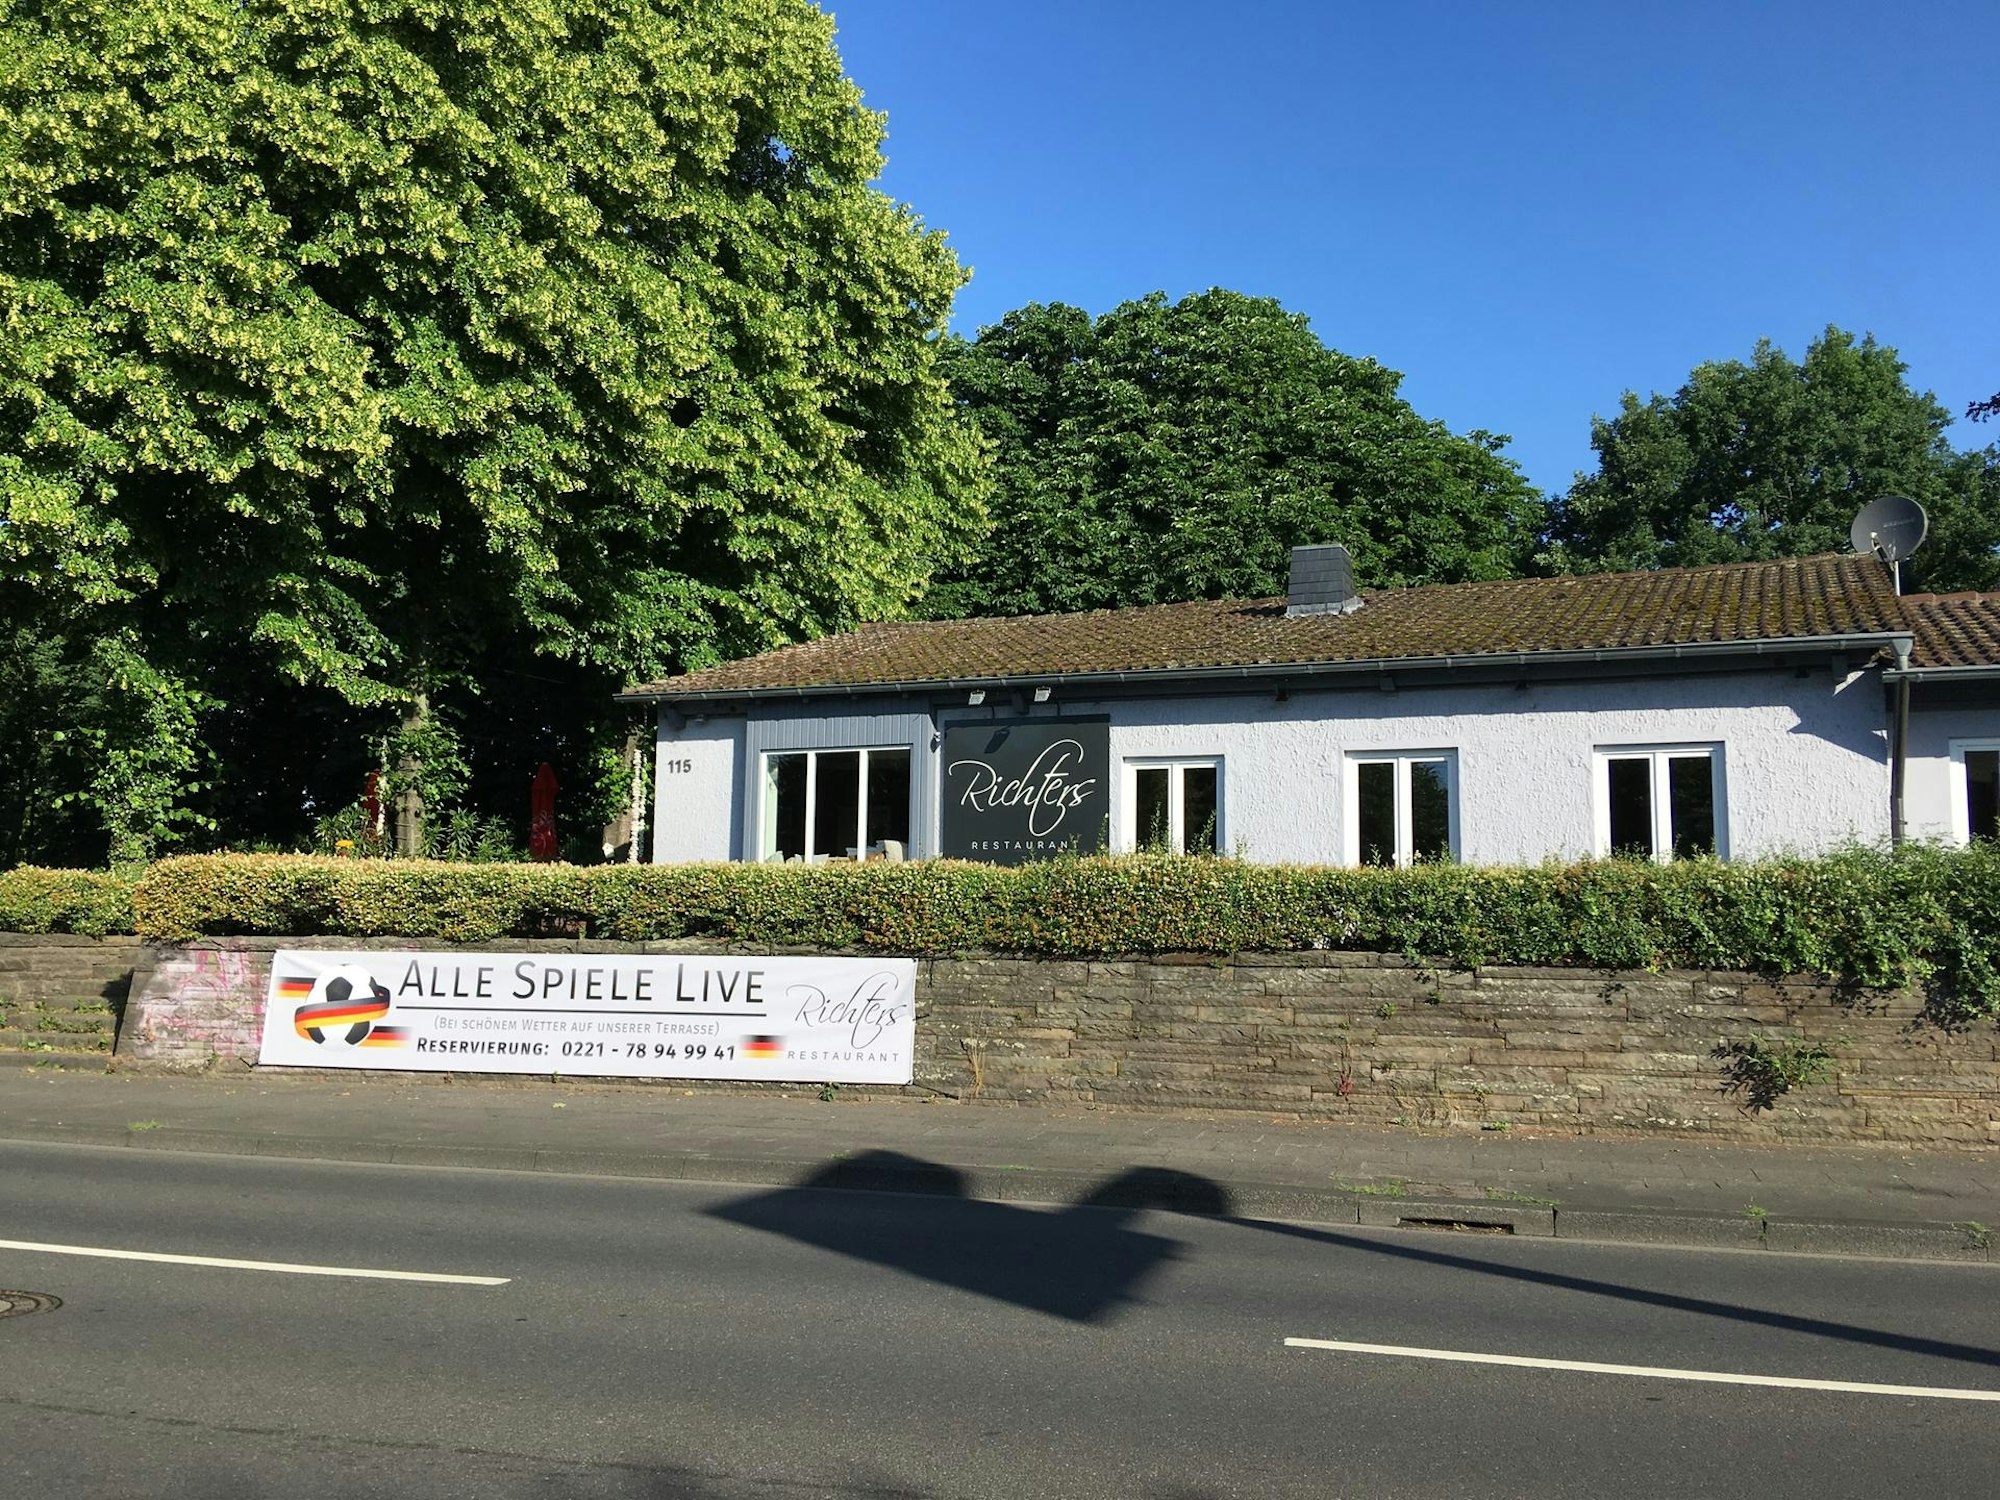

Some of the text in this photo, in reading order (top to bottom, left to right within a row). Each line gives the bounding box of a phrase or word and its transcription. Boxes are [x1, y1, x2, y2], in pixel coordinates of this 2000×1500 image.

[667, 759, 692, 774] 115
[948, 738, 1097, 837] Richters
[971, 841, 1079, 850] RESTAURANT
[398, 959, 766, 1004] ALLE SPIELE LIVE
[785, 970, 908, 1050] Richters
[416, 1037, 550, 1056] RESERVIERUNG:
[562, 1041, 605, 1057] 0221
[626, 1042, 647, 1059] 78
[654, 1044, 677, 1060] 94
[684, 1044, 707, 1060] 99
[714, 1045, 735, 1061] 41
[787, 1051, 900, 1062] RESTAURANT
